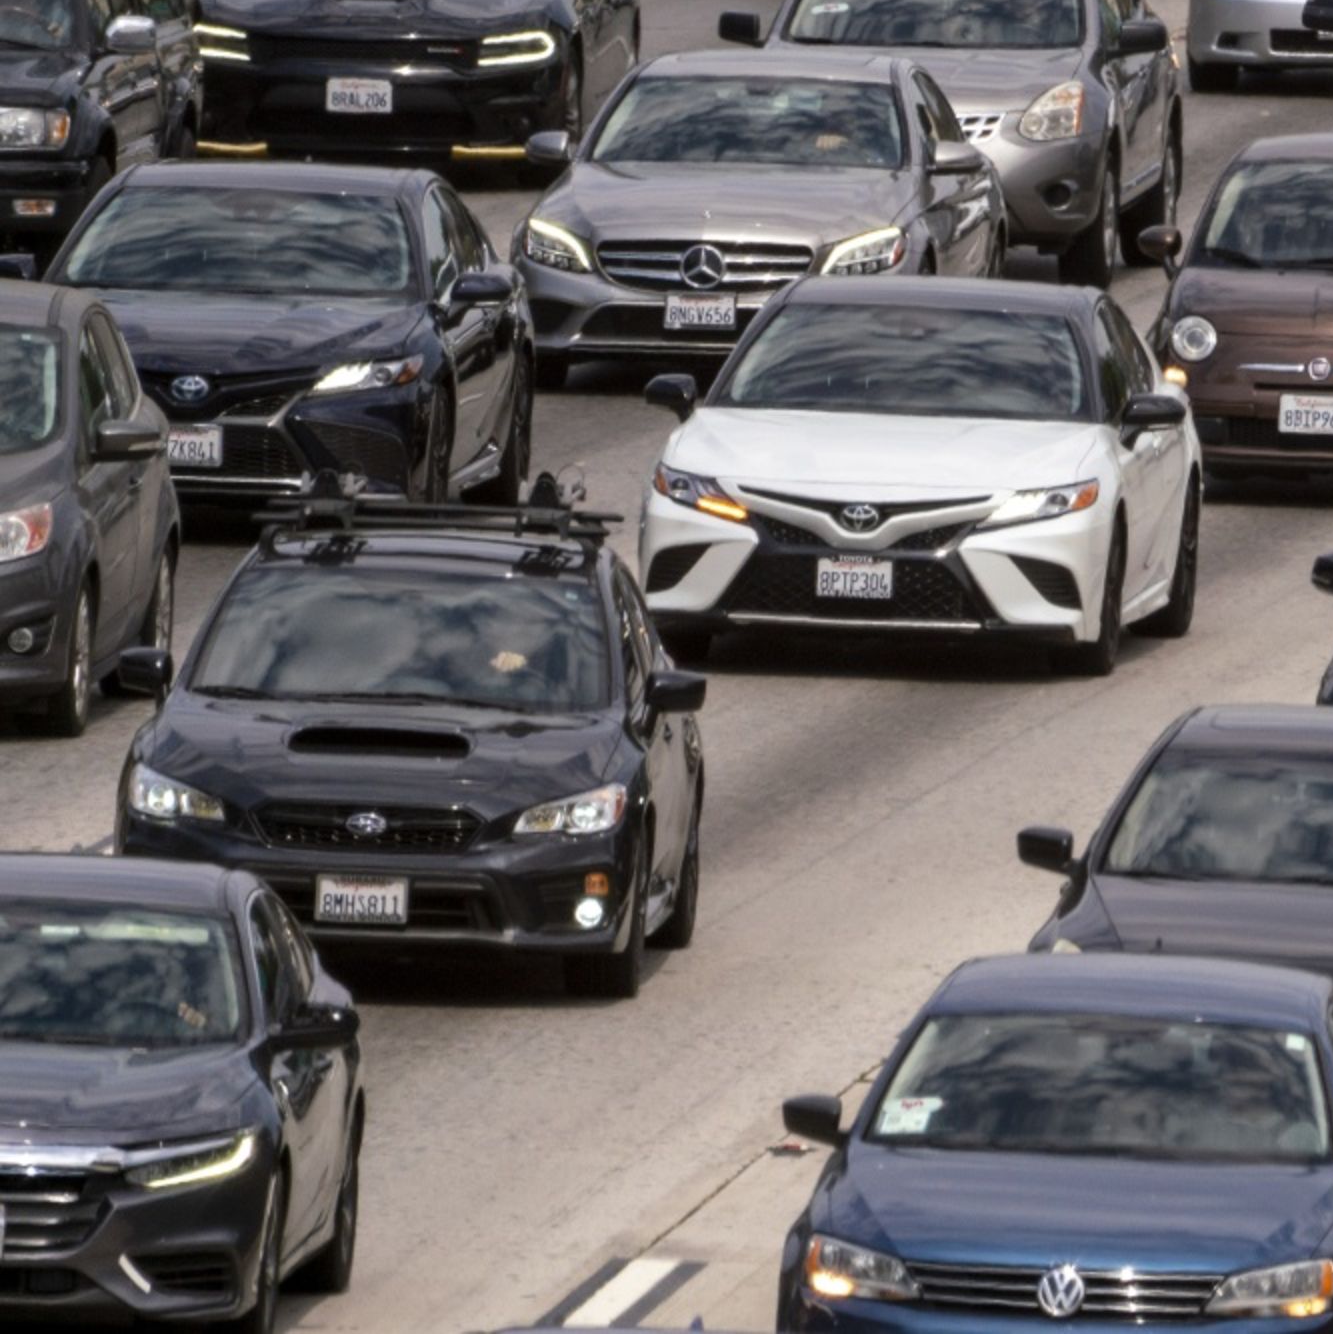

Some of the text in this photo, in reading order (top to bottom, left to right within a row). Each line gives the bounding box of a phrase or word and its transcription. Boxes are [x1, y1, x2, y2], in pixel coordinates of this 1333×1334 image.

[669, 306, 732, 325] 8NGV656
[820, 571, 889, 592] 8PTP304
[323, 893, 399, 916] 8MHS811
